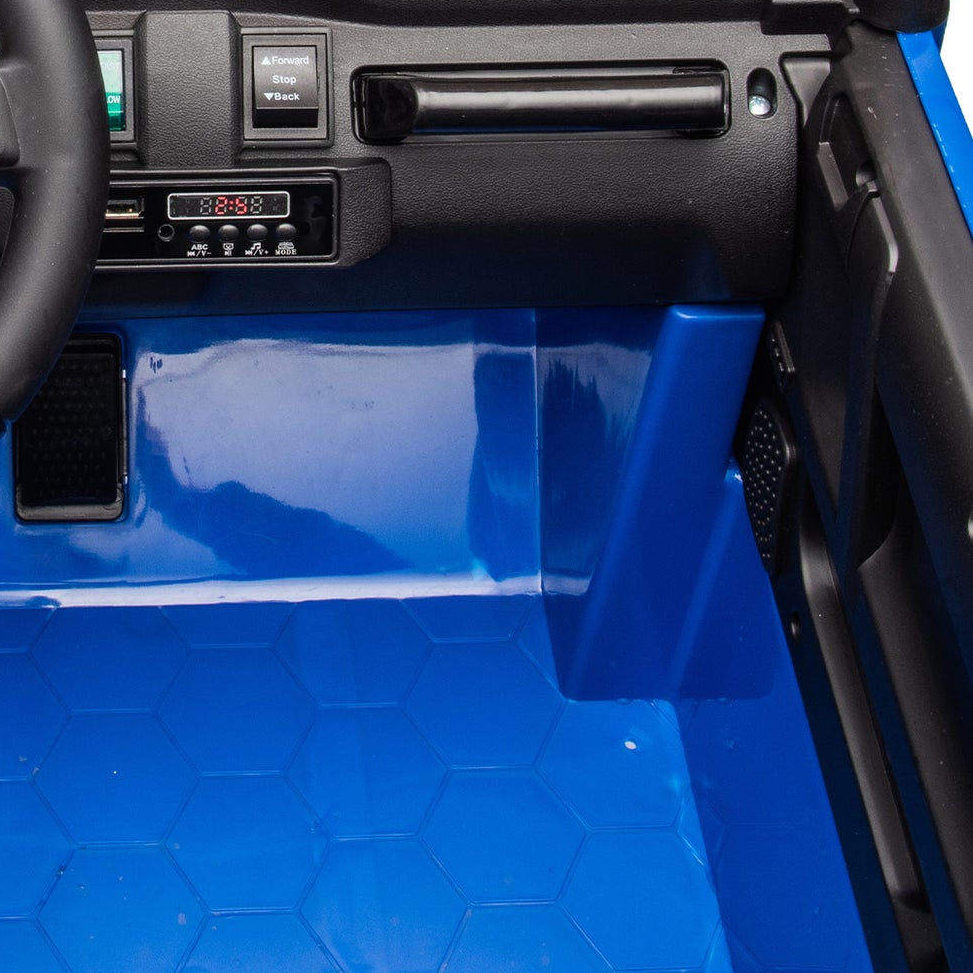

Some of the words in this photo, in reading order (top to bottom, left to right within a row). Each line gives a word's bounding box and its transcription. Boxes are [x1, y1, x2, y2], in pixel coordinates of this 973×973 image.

[272, 55, 309, 65] Forward
[272, 74, 297, 85] Stop
[107, 95, 121, 103] OW
[274, 92, 300, 101] Back
